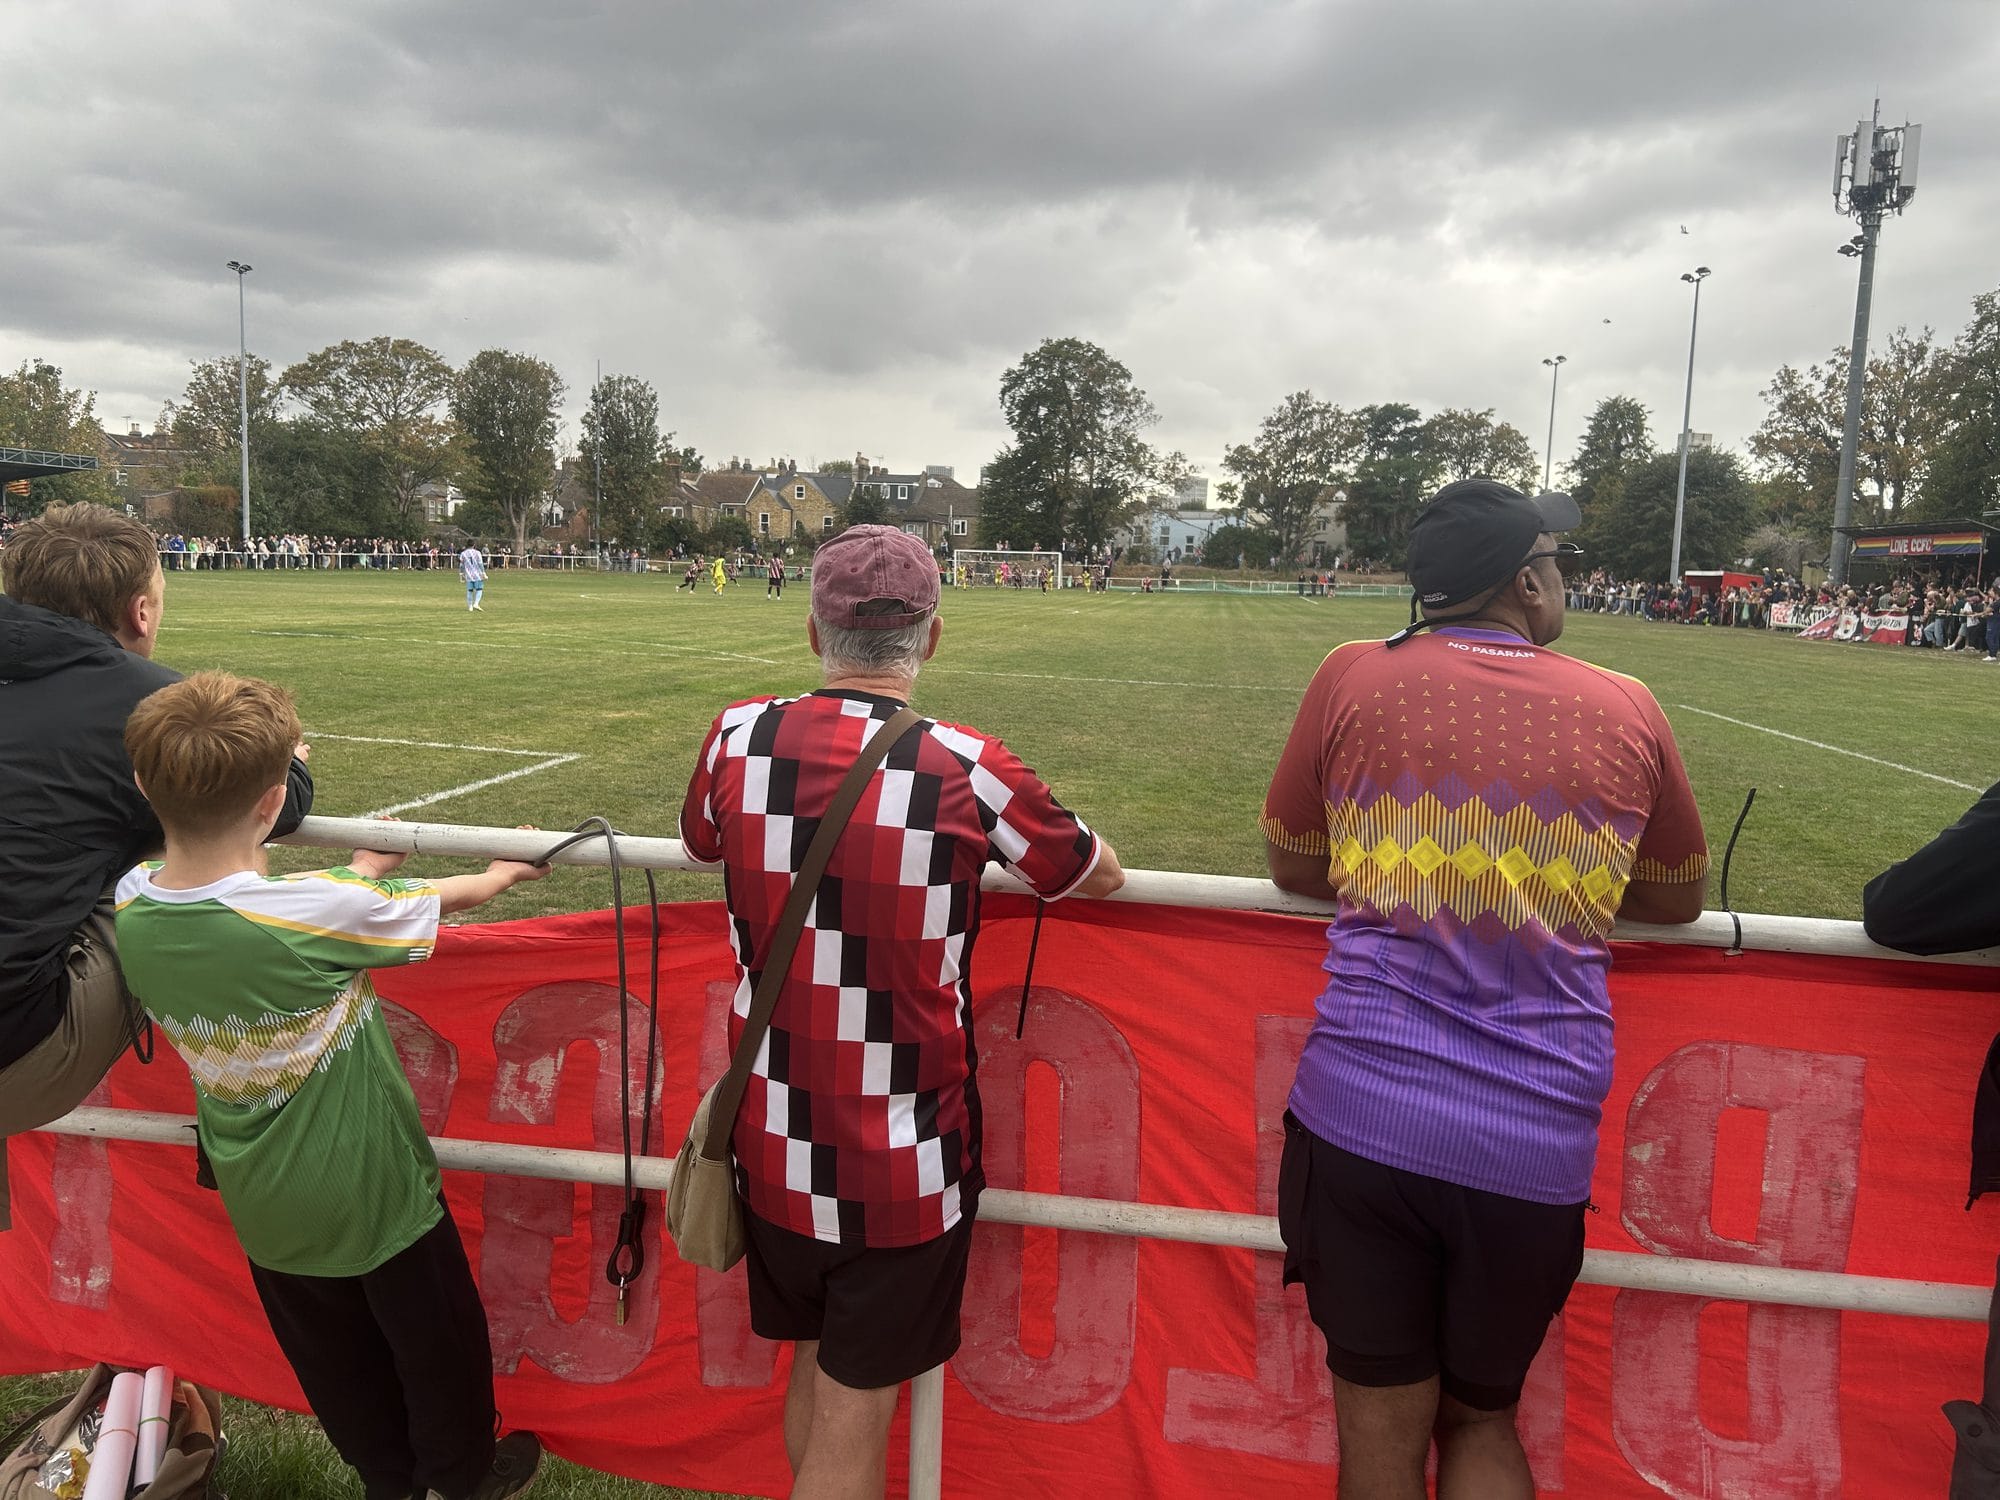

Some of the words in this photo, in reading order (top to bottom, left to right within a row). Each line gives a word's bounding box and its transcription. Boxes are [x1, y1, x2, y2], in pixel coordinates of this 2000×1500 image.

[1890, 538, 1909, 553] LOVE
[1911, 537, 1932, 552] CCFC
[1447, 641, 1469, 651] NO
[1472, 646, 1536, 658] PASARÁN
